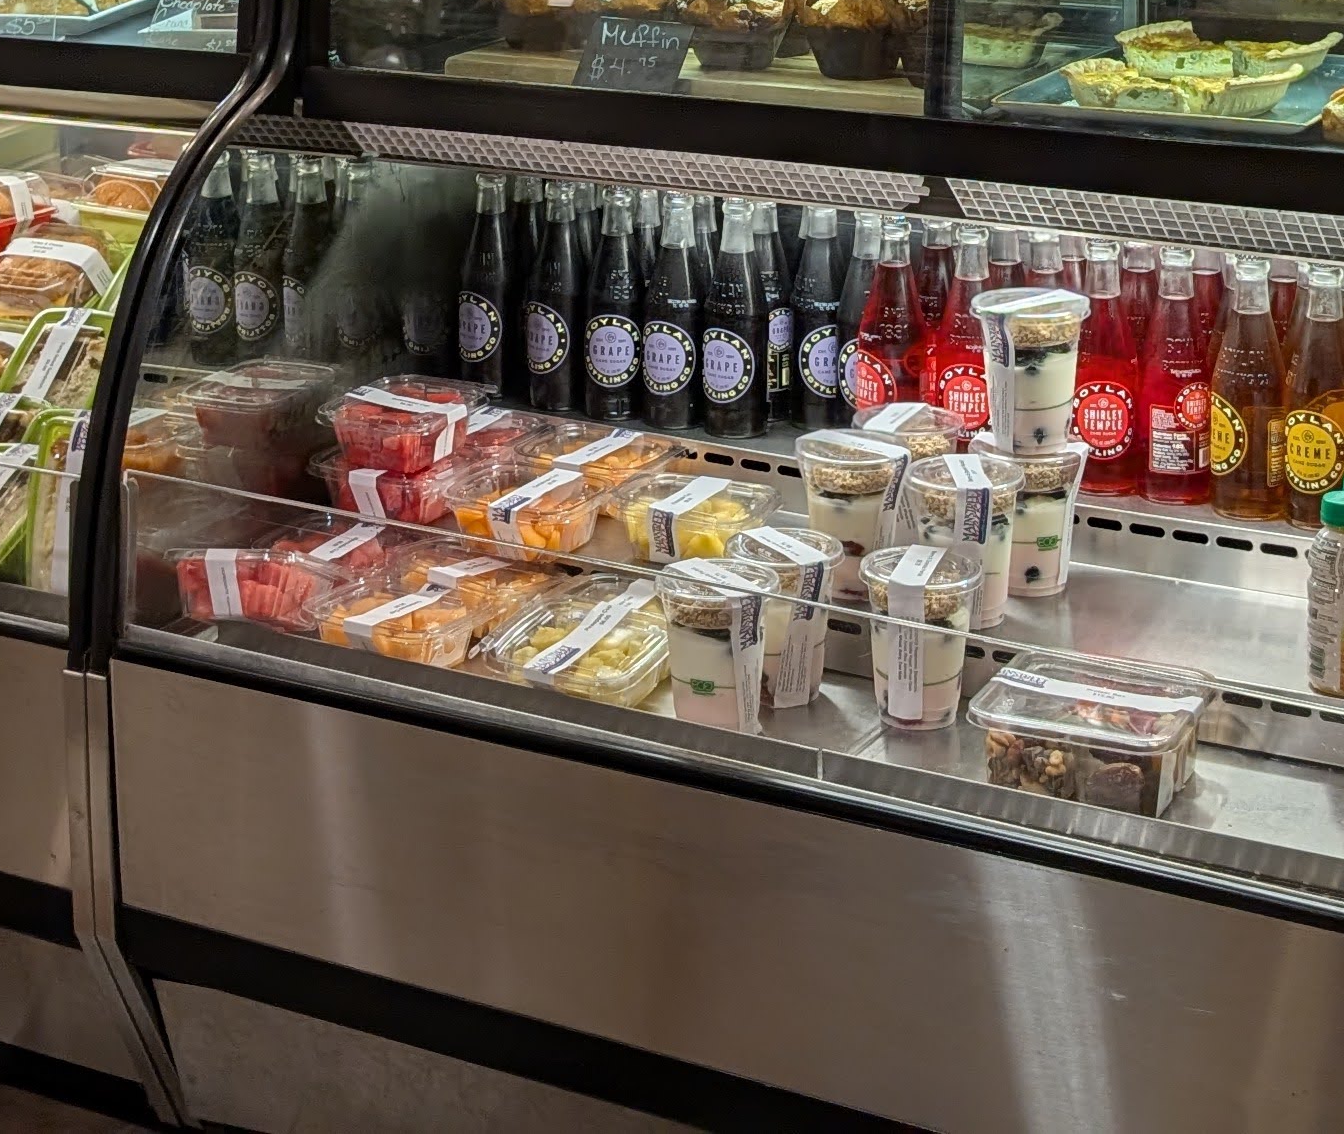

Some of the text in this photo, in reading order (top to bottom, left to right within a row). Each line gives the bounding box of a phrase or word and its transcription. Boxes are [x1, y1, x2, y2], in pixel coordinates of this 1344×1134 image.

[602, 22, 680, 50] Muffin
[586, 317, 640, 339] BOYLAN
[593, 345, 630, 356] GRAPE
[1074, 384, 1133, 408] BOYLAN
[1084, 409, 1123, 419] SHIRLEY
[1084, 420, 1123, 431] TEMPLE
[1290, 446, 1332, 460] CREME
